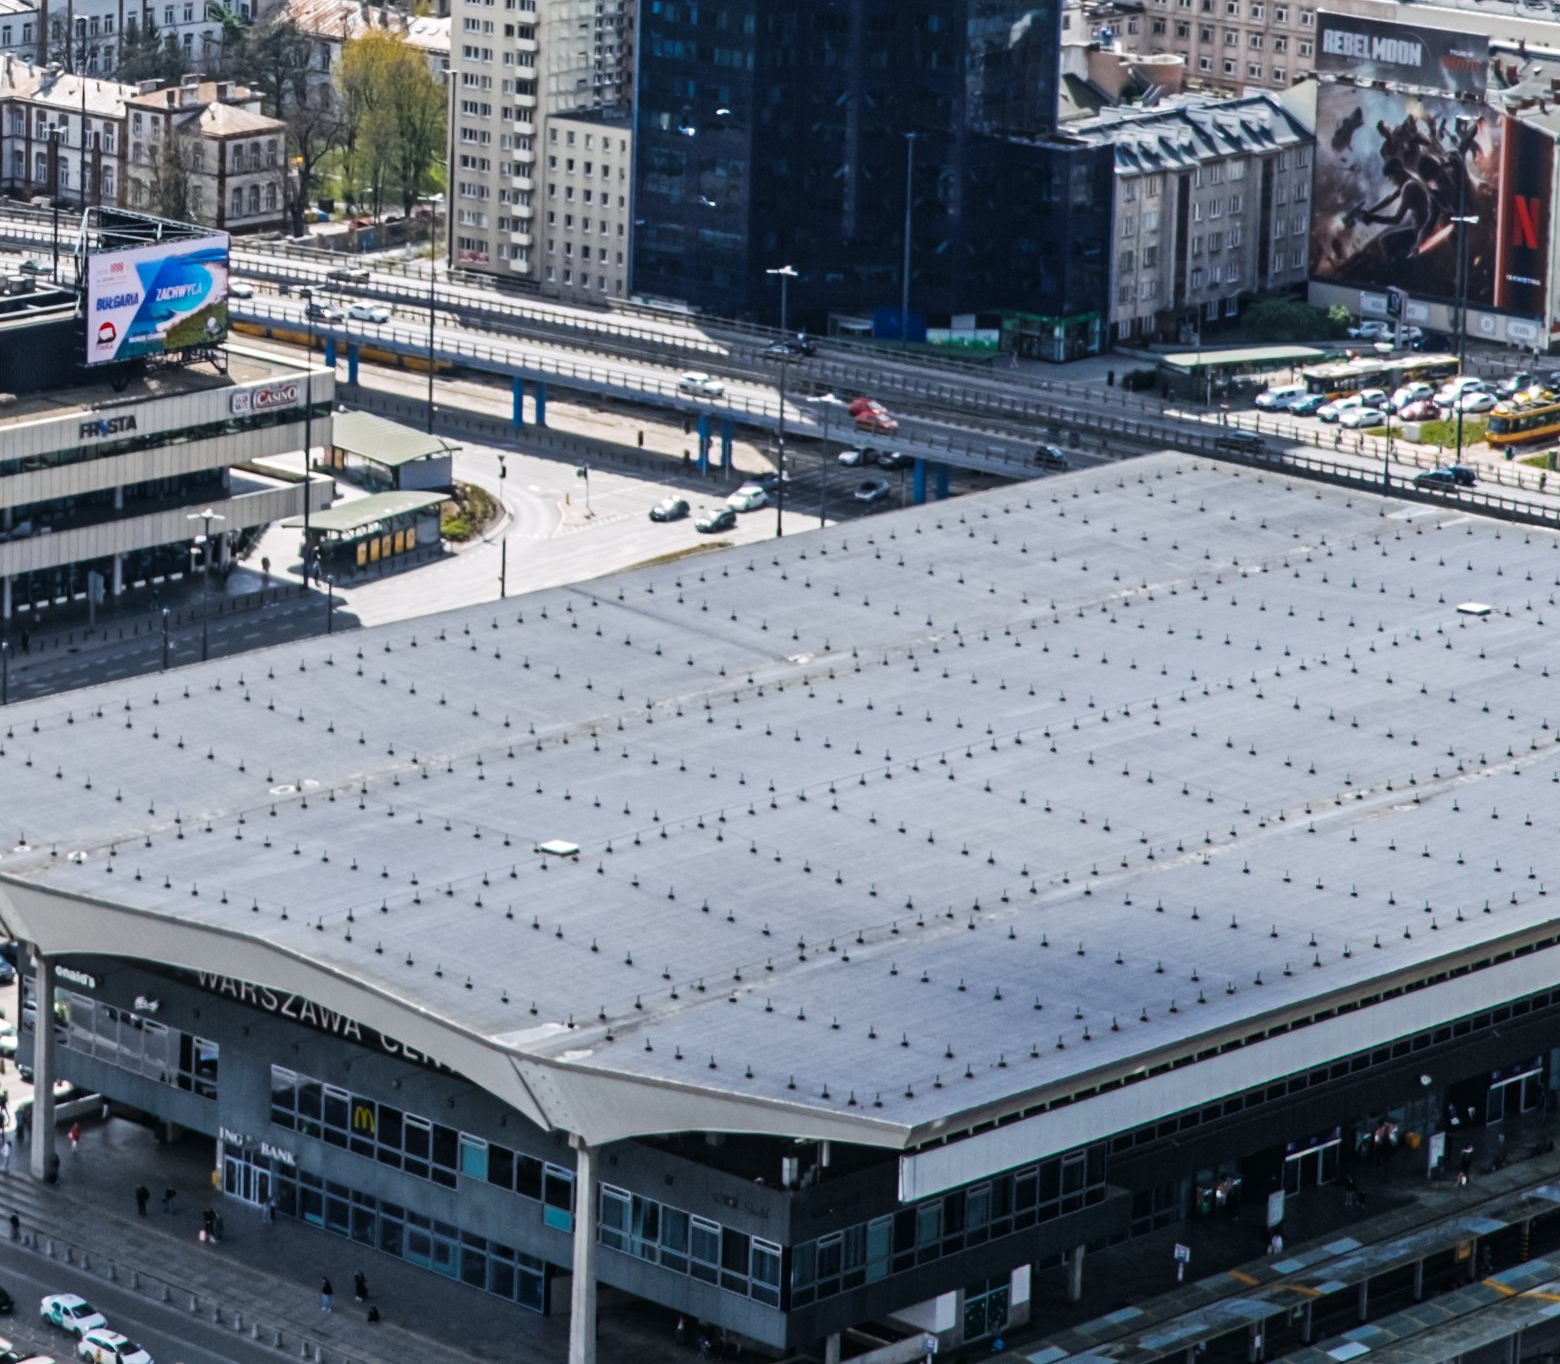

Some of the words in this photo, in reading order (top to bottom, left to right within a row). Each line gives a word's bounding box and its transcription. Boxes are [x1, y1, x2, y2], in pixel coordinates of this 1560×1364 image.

[1323, 29, 1371, 60] REBEL
[1372, 36, 1422, 67] MOON
[1513, 194, 1540, 250] N
[96, 292, 138, 311] BUŁGARIA
[155, 283, 202, 302] ZACHWYCA
[198, 971, 361, 1040] WARSZAWA
[219, 1126, 243, 1145] ING
[261, 1142, 296, 1166] BANK
